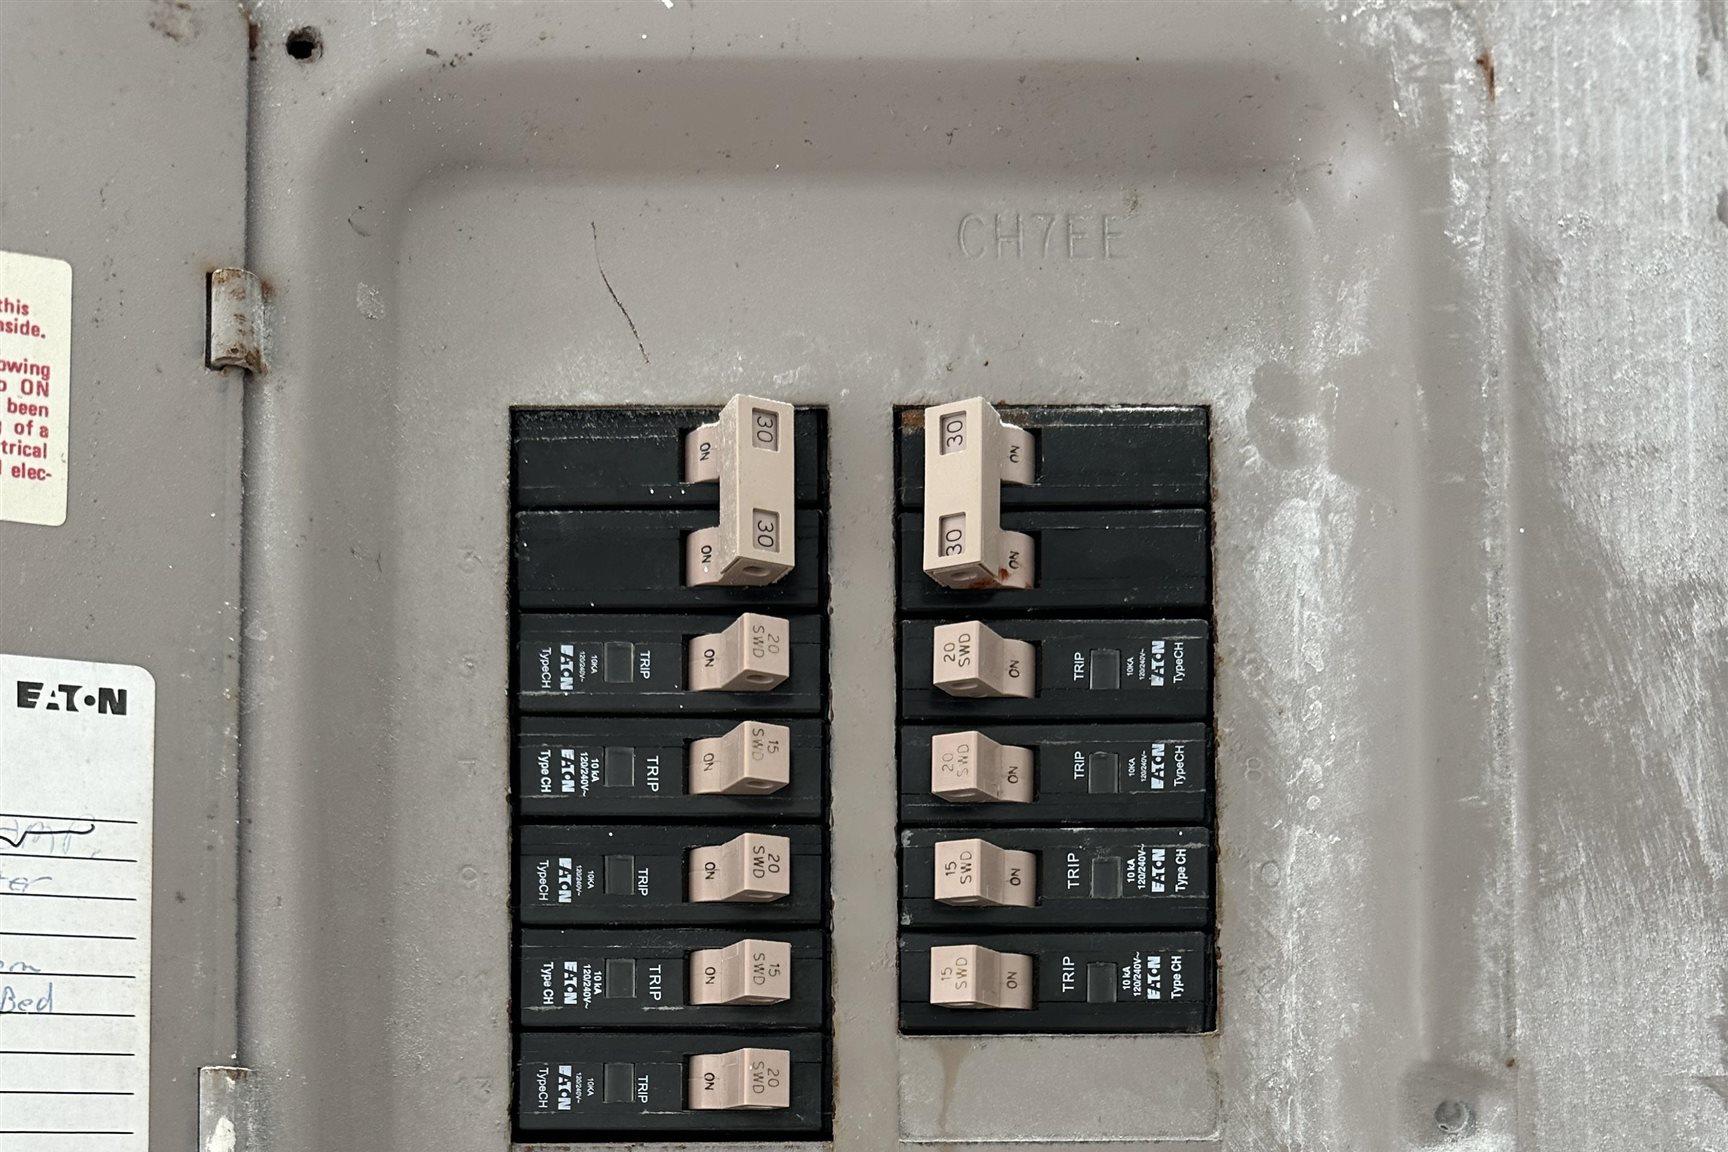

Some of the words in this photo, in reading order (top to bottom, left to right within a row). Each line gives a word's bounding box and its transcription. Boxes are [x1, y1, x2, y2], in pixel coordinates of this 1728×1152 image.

[957, 213, 1125, 260] CH7EE
[21, 379, 49, 397] ON
[7, 397, 49, 417] been
[14, 420, 33, 436] of
[40, 425, 48, 438] a
[756, 416, 774, 443] 30
[946, 420, 964, 447] 30
[1, 439, 47, 459] trical
[699, 442, 711, 461] ON
[12, 462, 52, 480] elec-
[757, 520, 774, 547] 30
[945, 529, 963, 556] 30
[700, 545, 712, 563] ON
[752, 625, 765, 658] SWD
[767, 633, 780, 654] 20
[943, 642, 956, 663] 20
[958, 633, 971, 668] SWD
[560, 644, 574, 690] EATON
[639, 650, 651, 680] TRIP
[704, 648, 715, 667] ON
[1008, 659, 1020, 678] ON
[1073, 652, 1085, 682] TRIP
[1150, 640, 1165, 686] EATON
[17, 680, 127, 716] EATON
[767, 740, 780, 754] 15
[561, 748, 575, 793] EATON
[646, 755, 659, 792] TRIP
[703, 753, 715, 772] ON
[941, 752, 954, 773] 20
[1007, 766, 1018, 784] ON
[1073, 751, 1085, 780] TRIP
[1151, 743, 1165, 789] EATON
[704, 862, 716, 880] ON
[752, 845, 765, 879] SWD
[767, 853, 780, 874] 20
[945, 860, 957, 877] 15
[960, 850, 973, 885] SWD
[1067, 852, 1080, 889] TRIP
[1151, 848, 1166, 892] EATON
[558, 857, 572, 903] EATON
[638, 867, 649, 897] TRIP
[1010, 868, 1021, 886] ON
[649, 964, 662, 1001] TRIP
[704, 966, 716, 985] ON
[753, 952, 766, 986] SWD
[768, 963, 780, 977] 15
[940, 966, 953, 981] 15
[955, 957, 968, 990] SWD
[1006, 971, 1018, 990] ON
[1062, 956, 1075, 992] TRIP
[1147, 955, 1161, 999] EATON
[564, 961, 578, 1005] EATON
[0, 982, 53, 1012] Bed
[558, 1065, 572, 1110] EATON
[638, 1075, 649, 1104] TRIP
[704, 1072, 715, 1091] ON
[752, 1061, 765, 1094] SWD
[767, 1068, 780, 1088] 20
